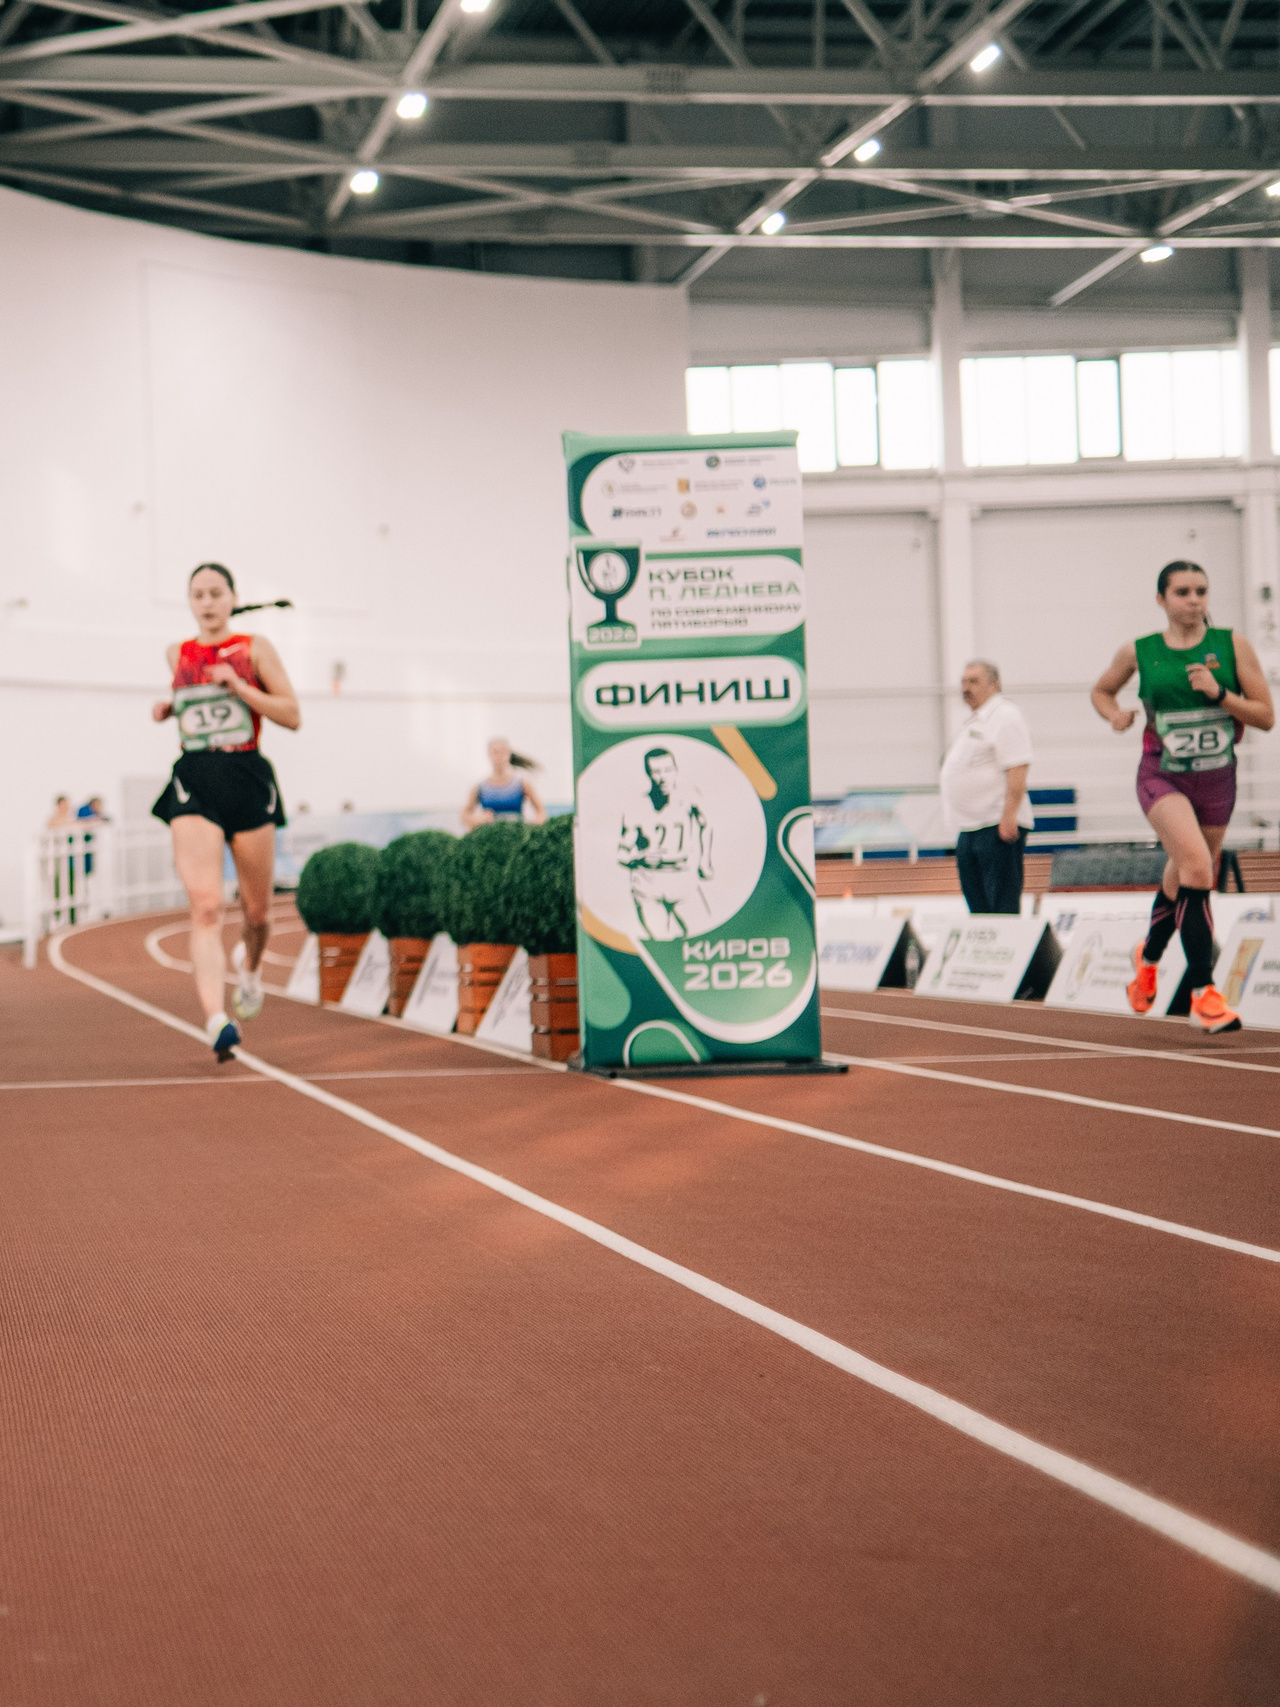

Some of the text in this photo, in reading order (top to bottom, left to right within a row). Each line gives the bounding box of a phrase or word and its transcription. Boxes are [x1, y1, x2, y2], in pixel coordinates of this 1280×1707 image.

[648, 567, 734, 584] КУБОК
[680, 582, 802, 600] ЛЕДНЕВА
[595, 678, 791, 706] ФИНИШ
[194, 705, 232, 728] 19
[1174, 730, 1219, 752] 28
[682, 937, 791, 962] КИРОВ
[683, 961, 793, 991] 2026
